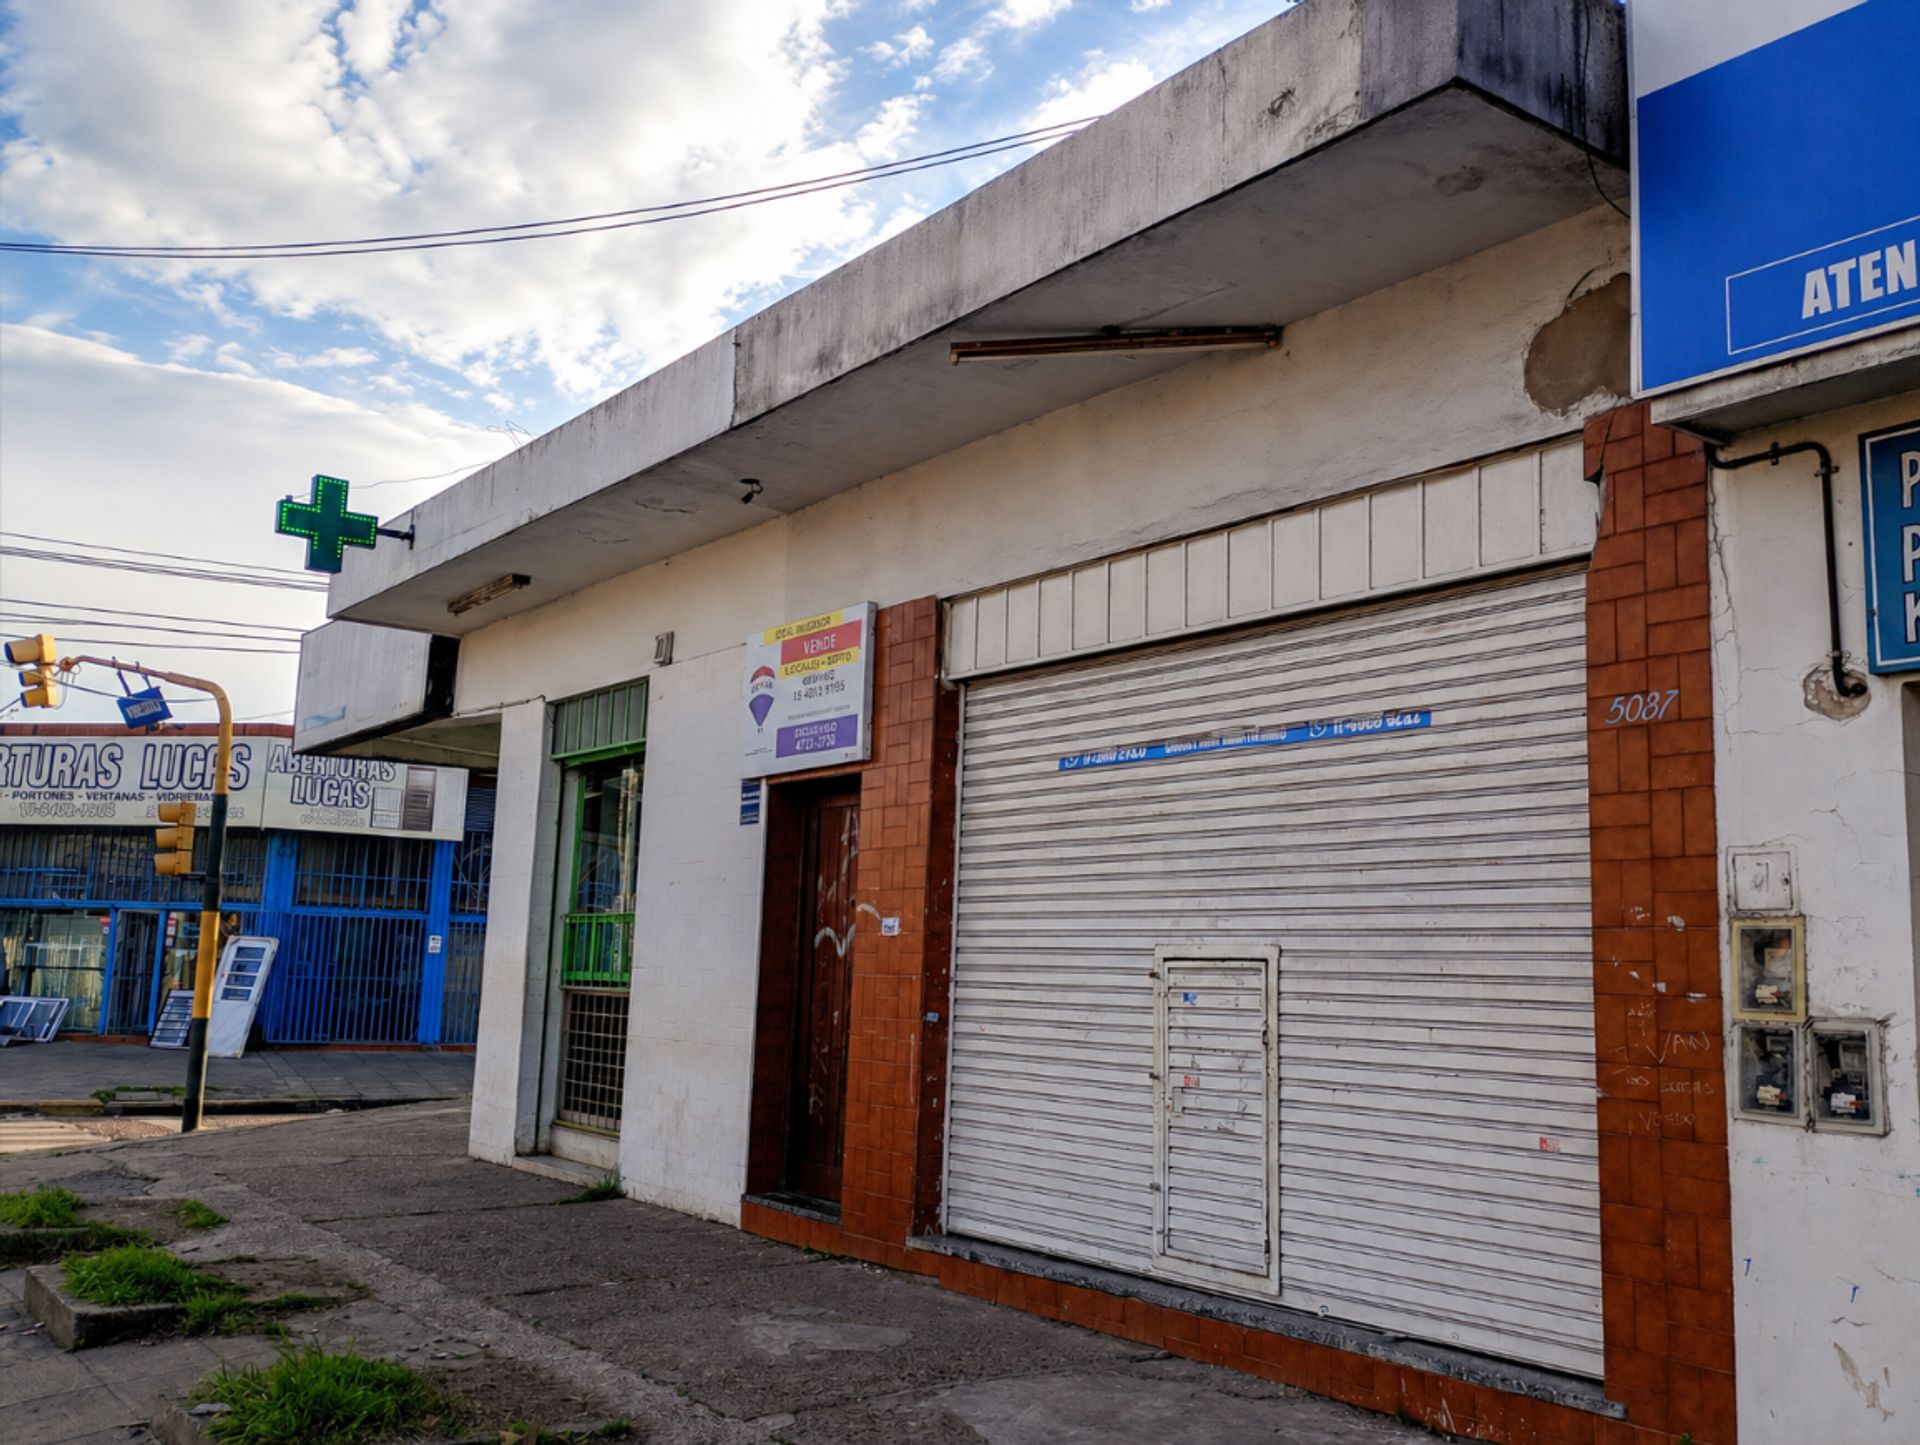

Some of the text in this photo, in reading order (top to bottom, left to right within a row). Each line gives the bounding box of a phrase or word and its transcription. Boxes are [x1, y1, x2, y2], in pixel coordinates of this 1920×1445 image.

[1801, 239, 1918, 319] ATEN
[803, 633, 837, 654] VENDE
[1605, 688, 1680, 724] 5087
[11, 790, 75, 801] PORTONES
[290, 775, 371, 809] LUCAS
